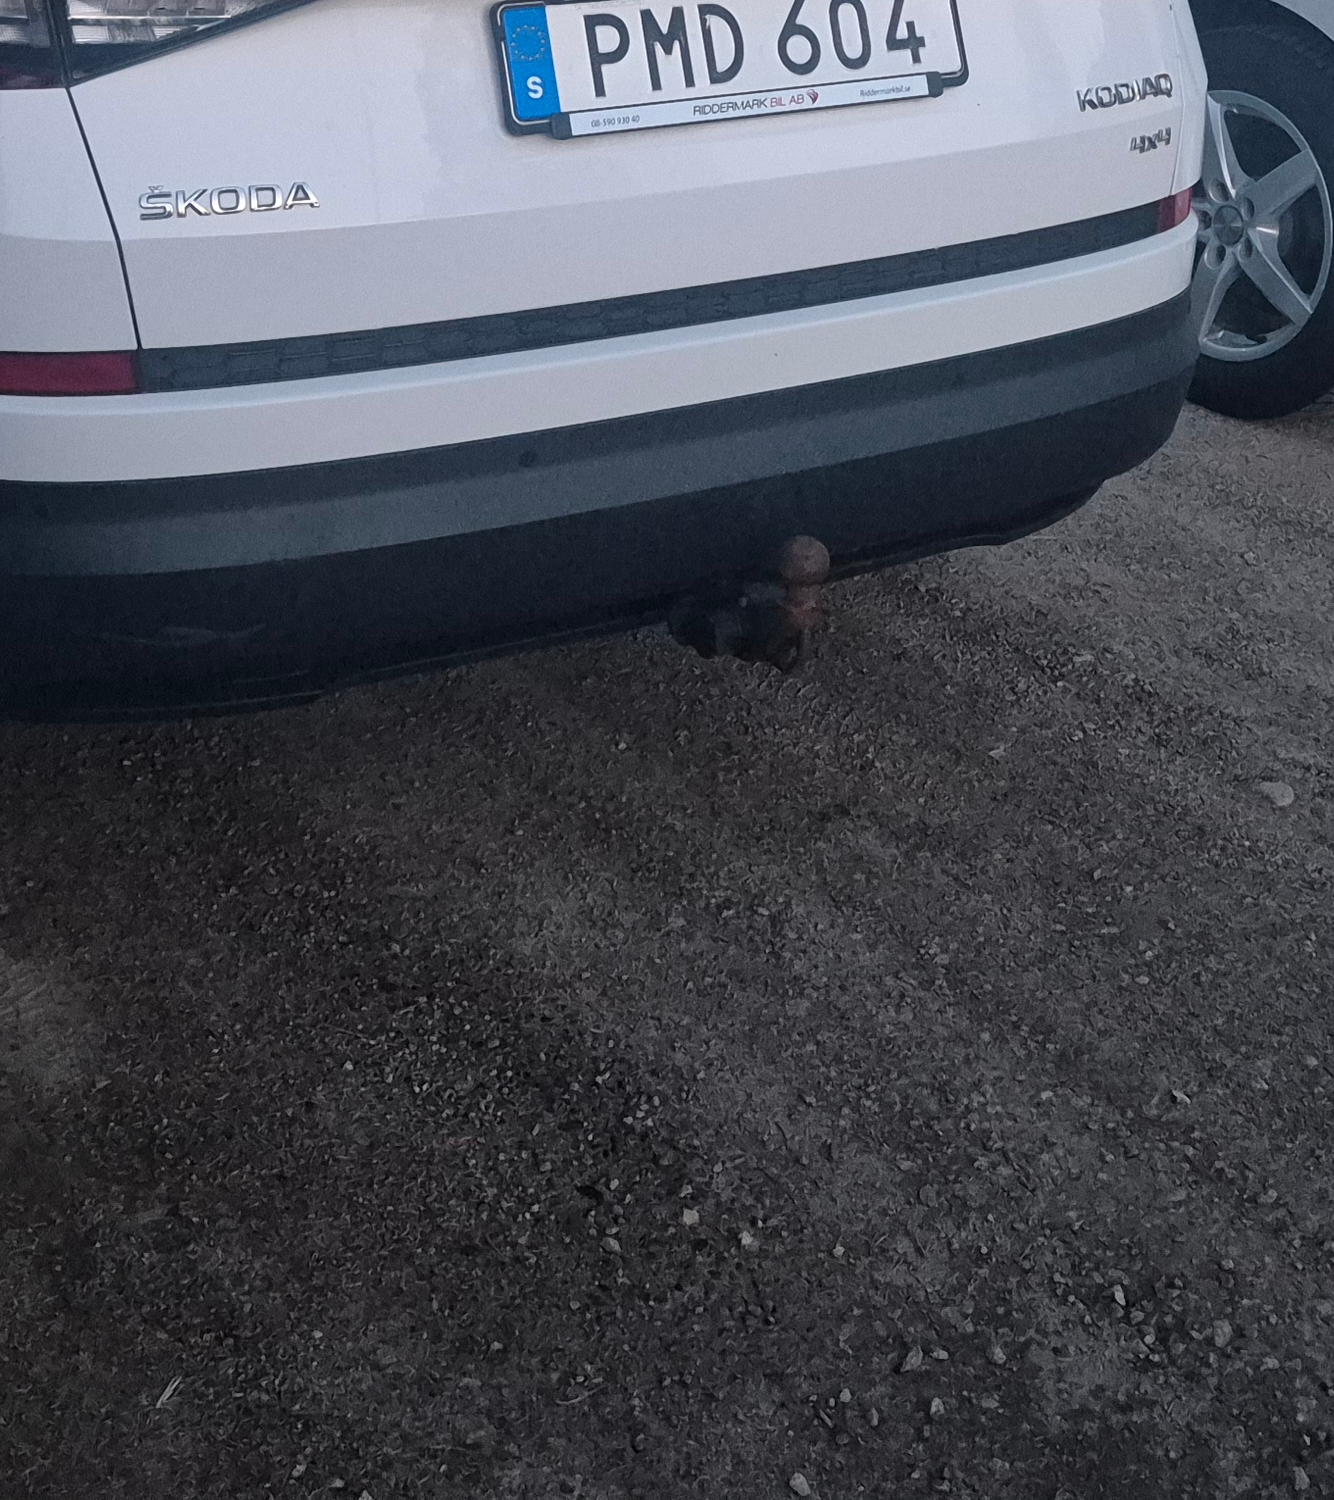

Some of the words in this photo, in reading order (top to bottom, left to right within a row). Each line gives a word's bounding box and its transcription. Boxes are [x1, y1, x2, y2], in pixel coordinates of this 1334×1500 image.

[584, 3, 745, 98] PMD
[526, 76, 543, 99] S
[1076, 73, 1173, 112] KODIAQ
[693, 98, 768, 116] RIDDERMARK
[770, 96, 786, 108] BIL
[789, 93, 805, 105] AB
[1129, 127, 1172, 153] 4x4
[138, 181, 320, 221] ŠKODA
